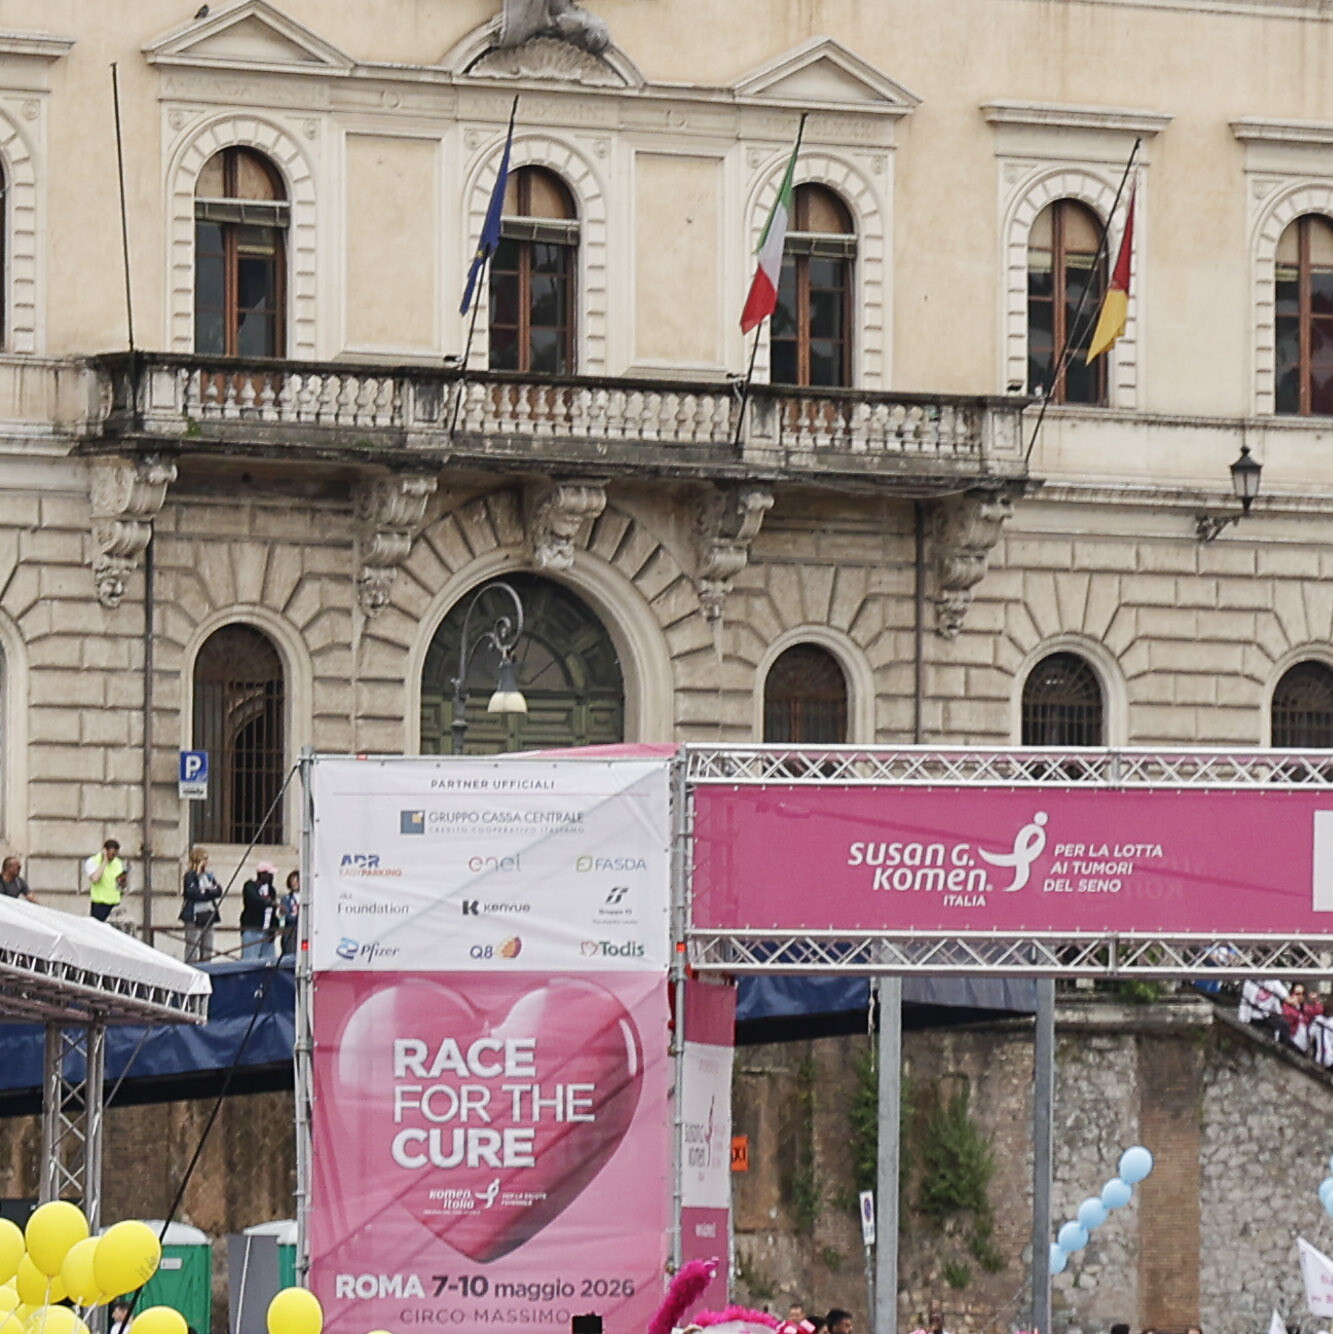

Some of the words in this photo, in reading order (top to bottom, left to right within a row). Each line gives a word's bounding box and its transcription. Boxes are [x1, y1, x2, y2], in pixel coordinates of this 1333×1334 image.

[186, 755, 201, 779] P
[430, 779, 488, 790] PARTNER
[493, 779, 555, 790] UFFICIALI
[428, 811, 479, 824] GRUPPO
[481, 811, 522, 824] CASSA
[523, 811, 584, 824] CENTRALE
[1054, 844, 1085, 858] PER
[1089, 844, 1110, 858] LA
[1113, 844, 1164, 858] LOTTA
[468, 853, 521, 873] enel
[595, 858, 647, 871] FASDA
[1051, 862, 1069, 876] AI
[1071, 862, 1134, 876] TUMORI
[1043, 879, 1074, 893] DEL
[1077, 879, 1123, 893] SENO
[337, 901, 409, 915] Foundation
[942, 895, 987, 907] ITALIA
[360, 941, 400, 963] Pfizer
[470, 945, 493, 959] Q8
[598, 941, 645, 957] Todis
[393, 1038, 537, 1078] RACE
[393, 1084, 492, 1123] FOR
[502, 1083, 596, 1123] THE
[391, 1127, 537, 1169] CURE
[335, 1273, 425, 1299] ROMA
[431, 1275, 489, 1298] 7-10
[493, 1276, 575, 1303] maggio
[579, 1278, 636, 1298] 2026
[400, 1308, 466, 1325] CIRCO
[473, 1308, 571, 1325] MASSIMO
